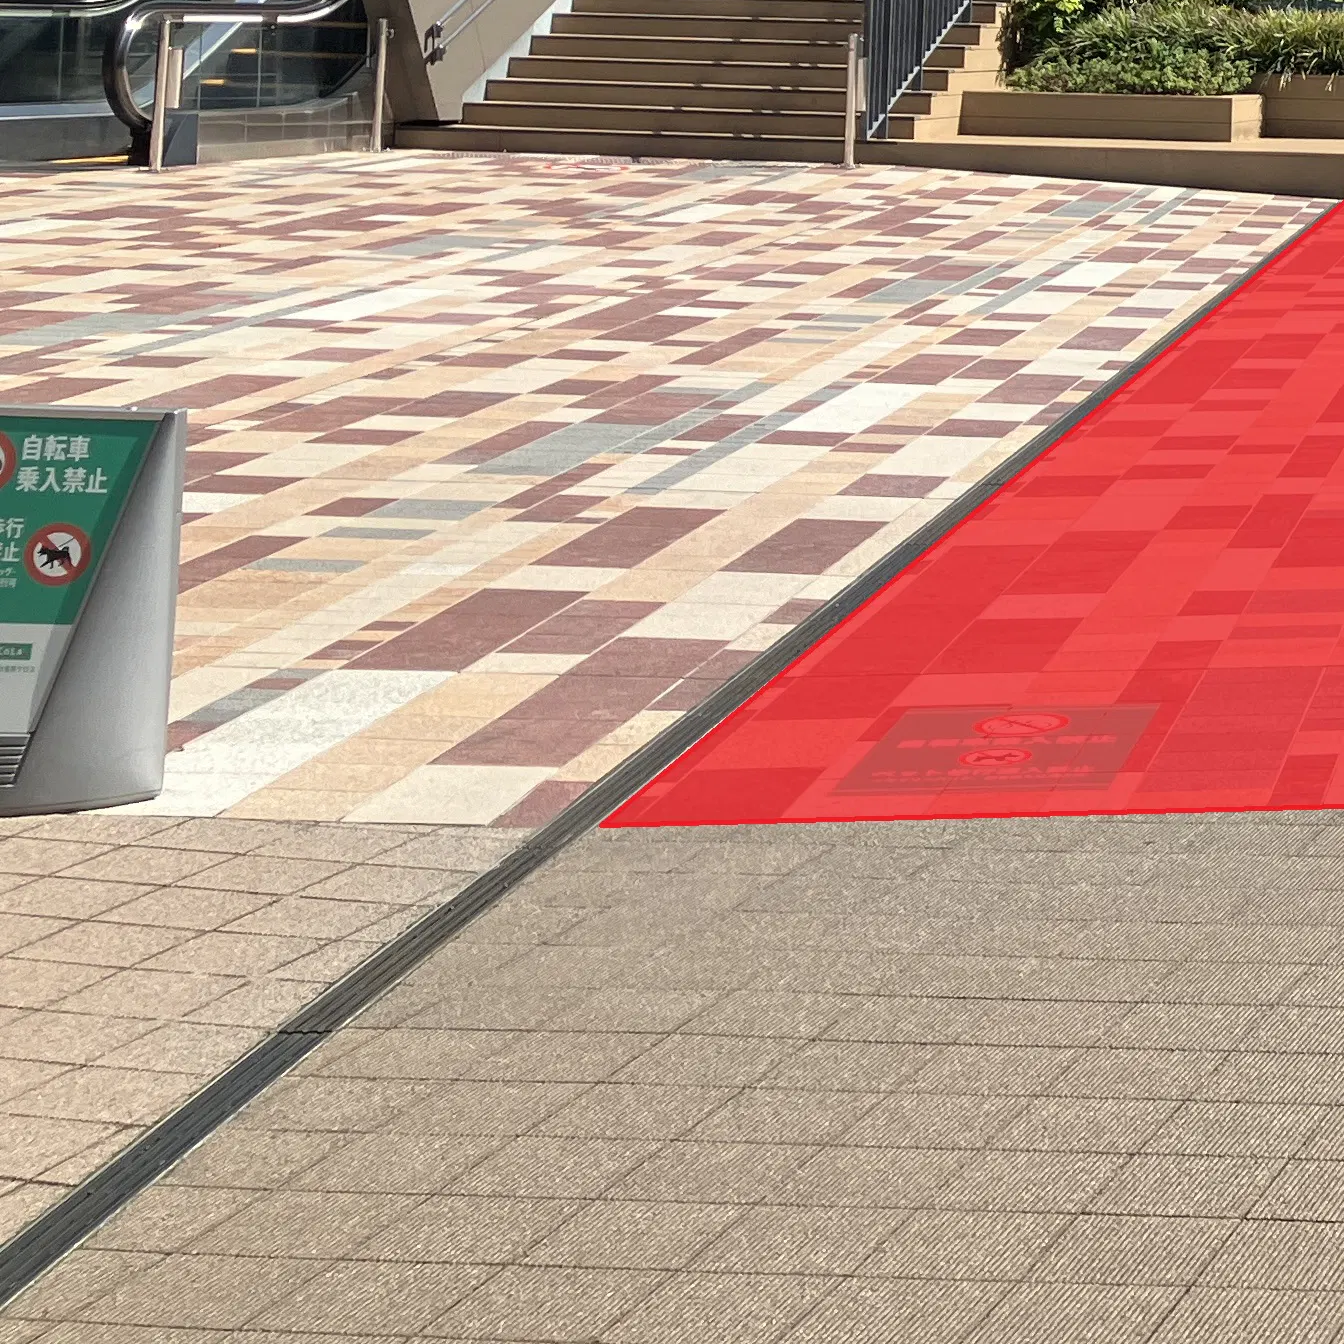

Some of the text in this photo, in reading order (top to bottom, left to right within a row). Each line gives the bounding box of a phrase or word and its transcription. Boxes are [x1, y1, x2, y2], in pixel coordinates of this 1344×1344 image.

[22, 435, 91, 461] 自転車
[15, 466, 108, 493] 乗入禁止
